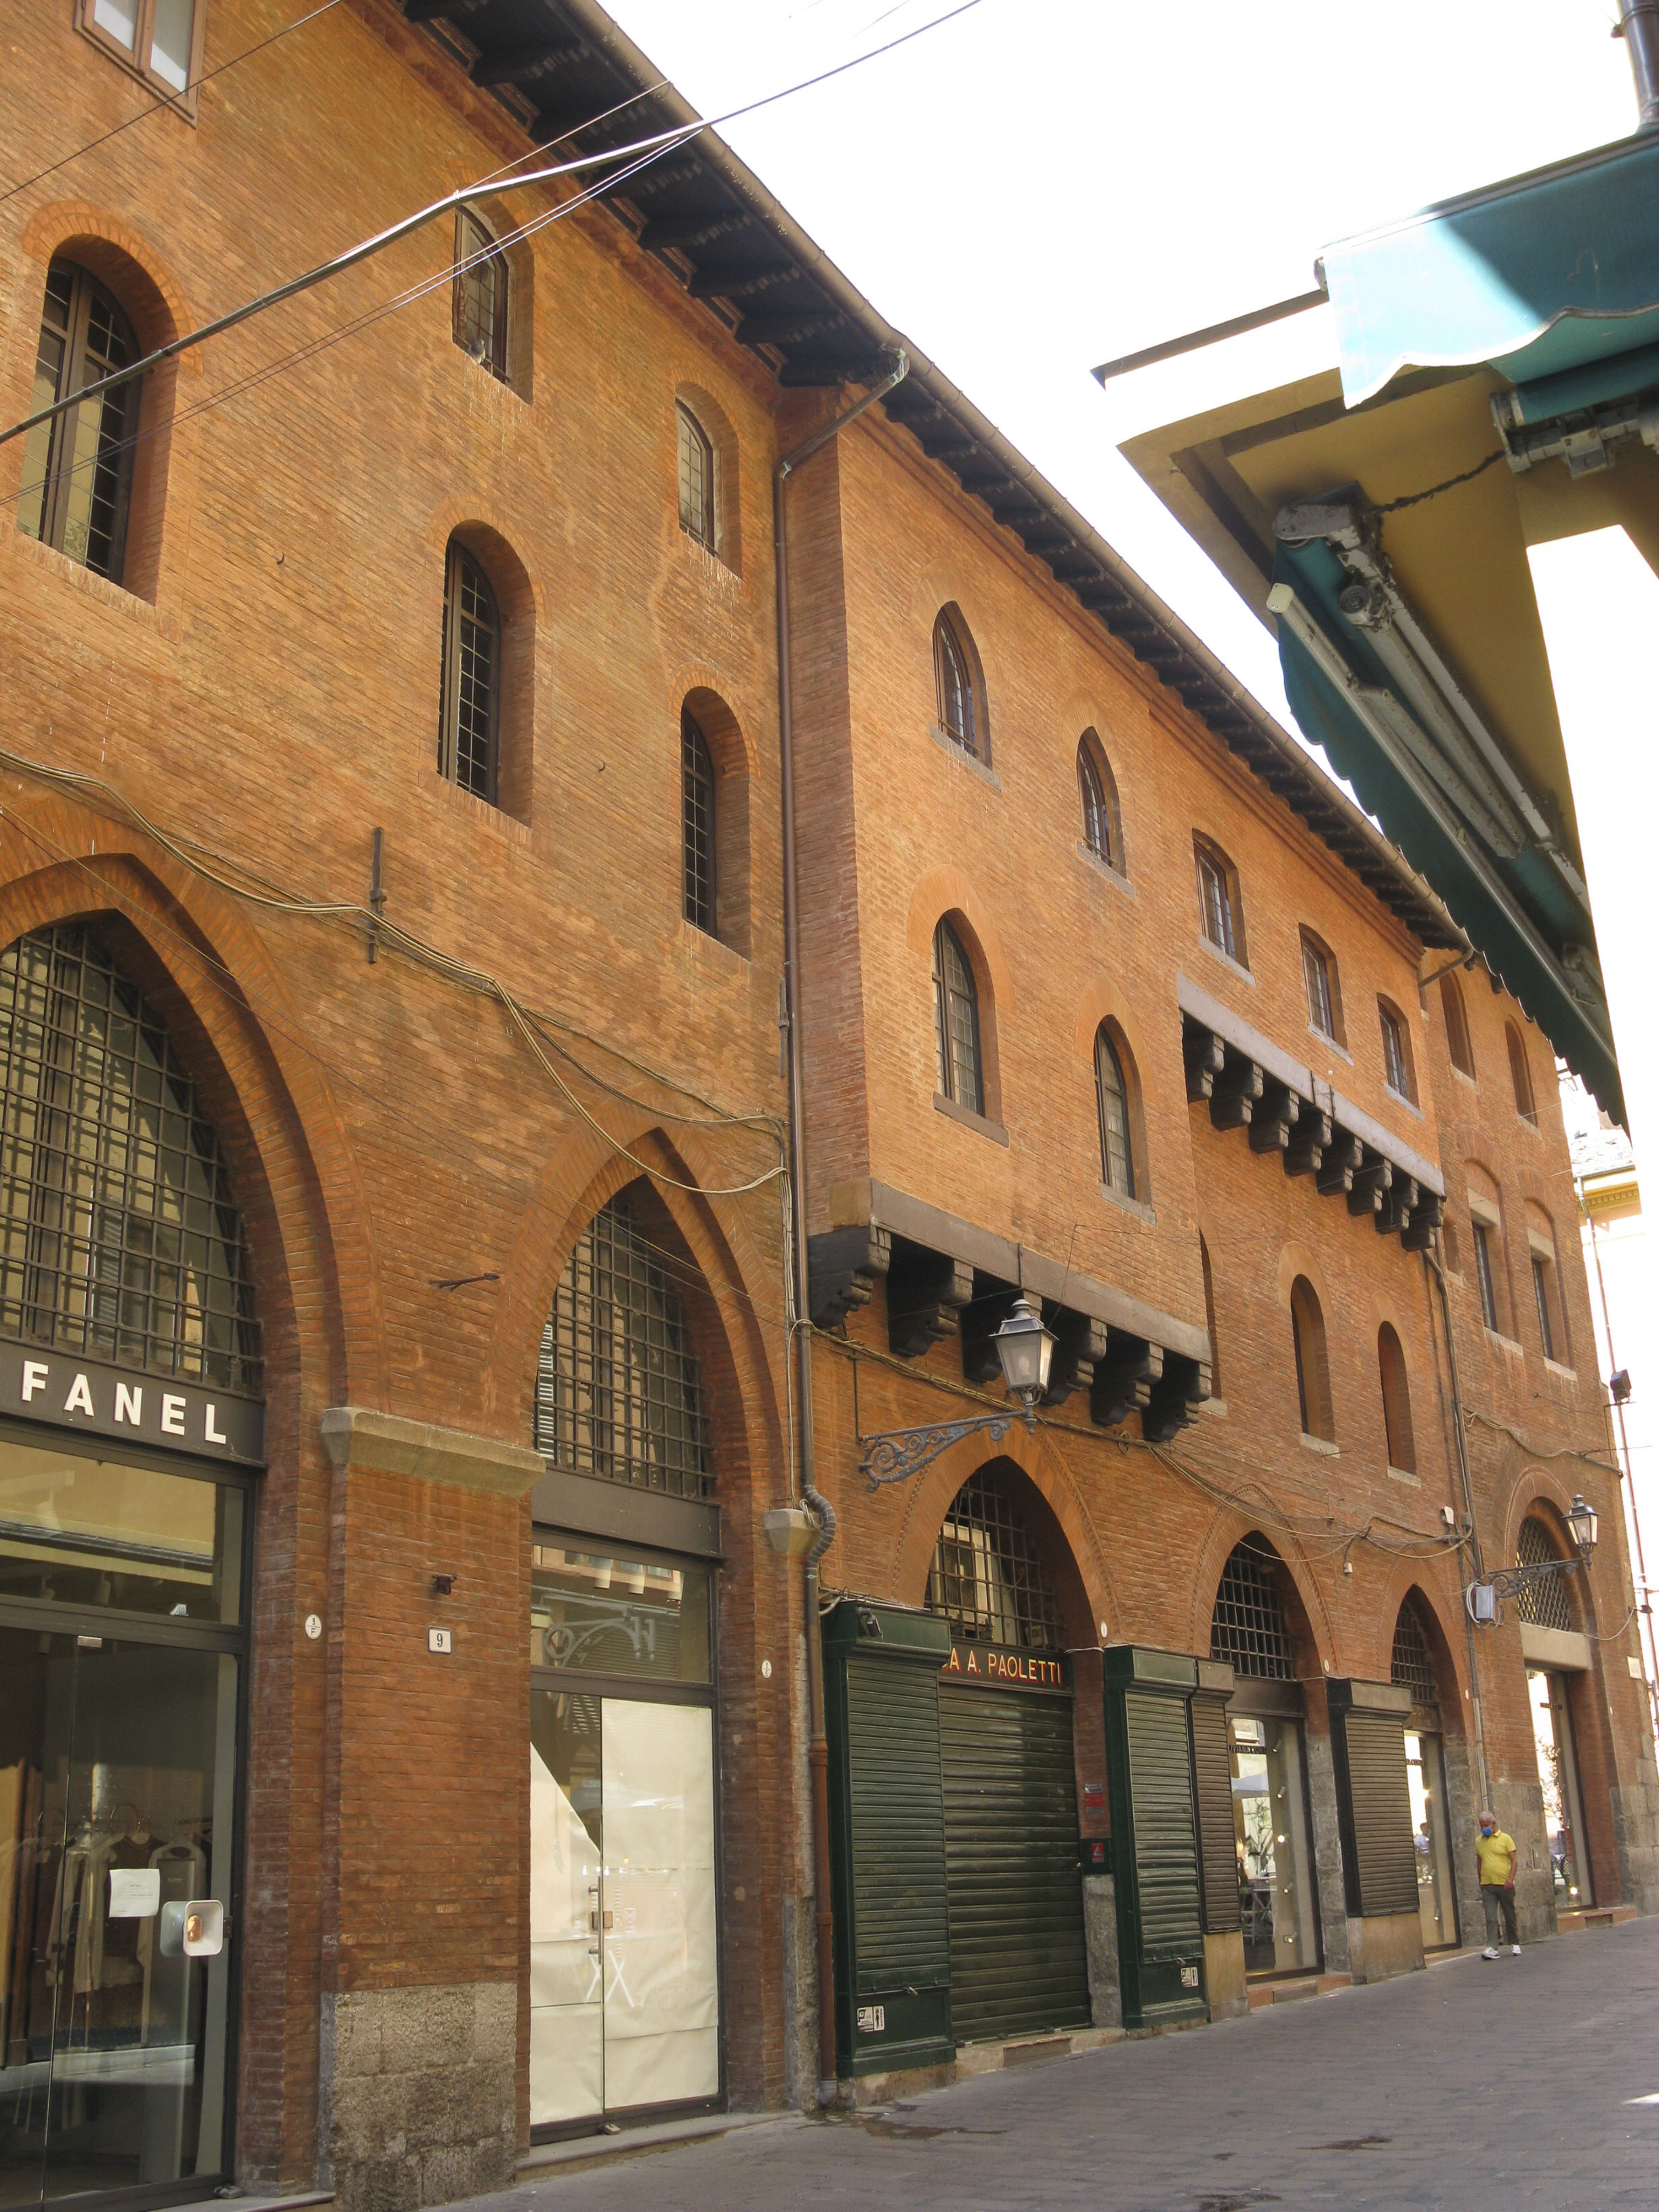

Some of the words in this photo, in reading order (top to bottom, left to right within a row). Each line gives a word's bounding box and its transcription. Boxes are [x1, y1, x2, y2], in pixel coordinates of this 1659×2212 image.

[22, 1360, 227, 1445] FANEL
[436, 1633, 443, 1648] 9
[942, 1647, 960, 1671] A
[987, 1652, 1062, 1685] PAOLETTI
